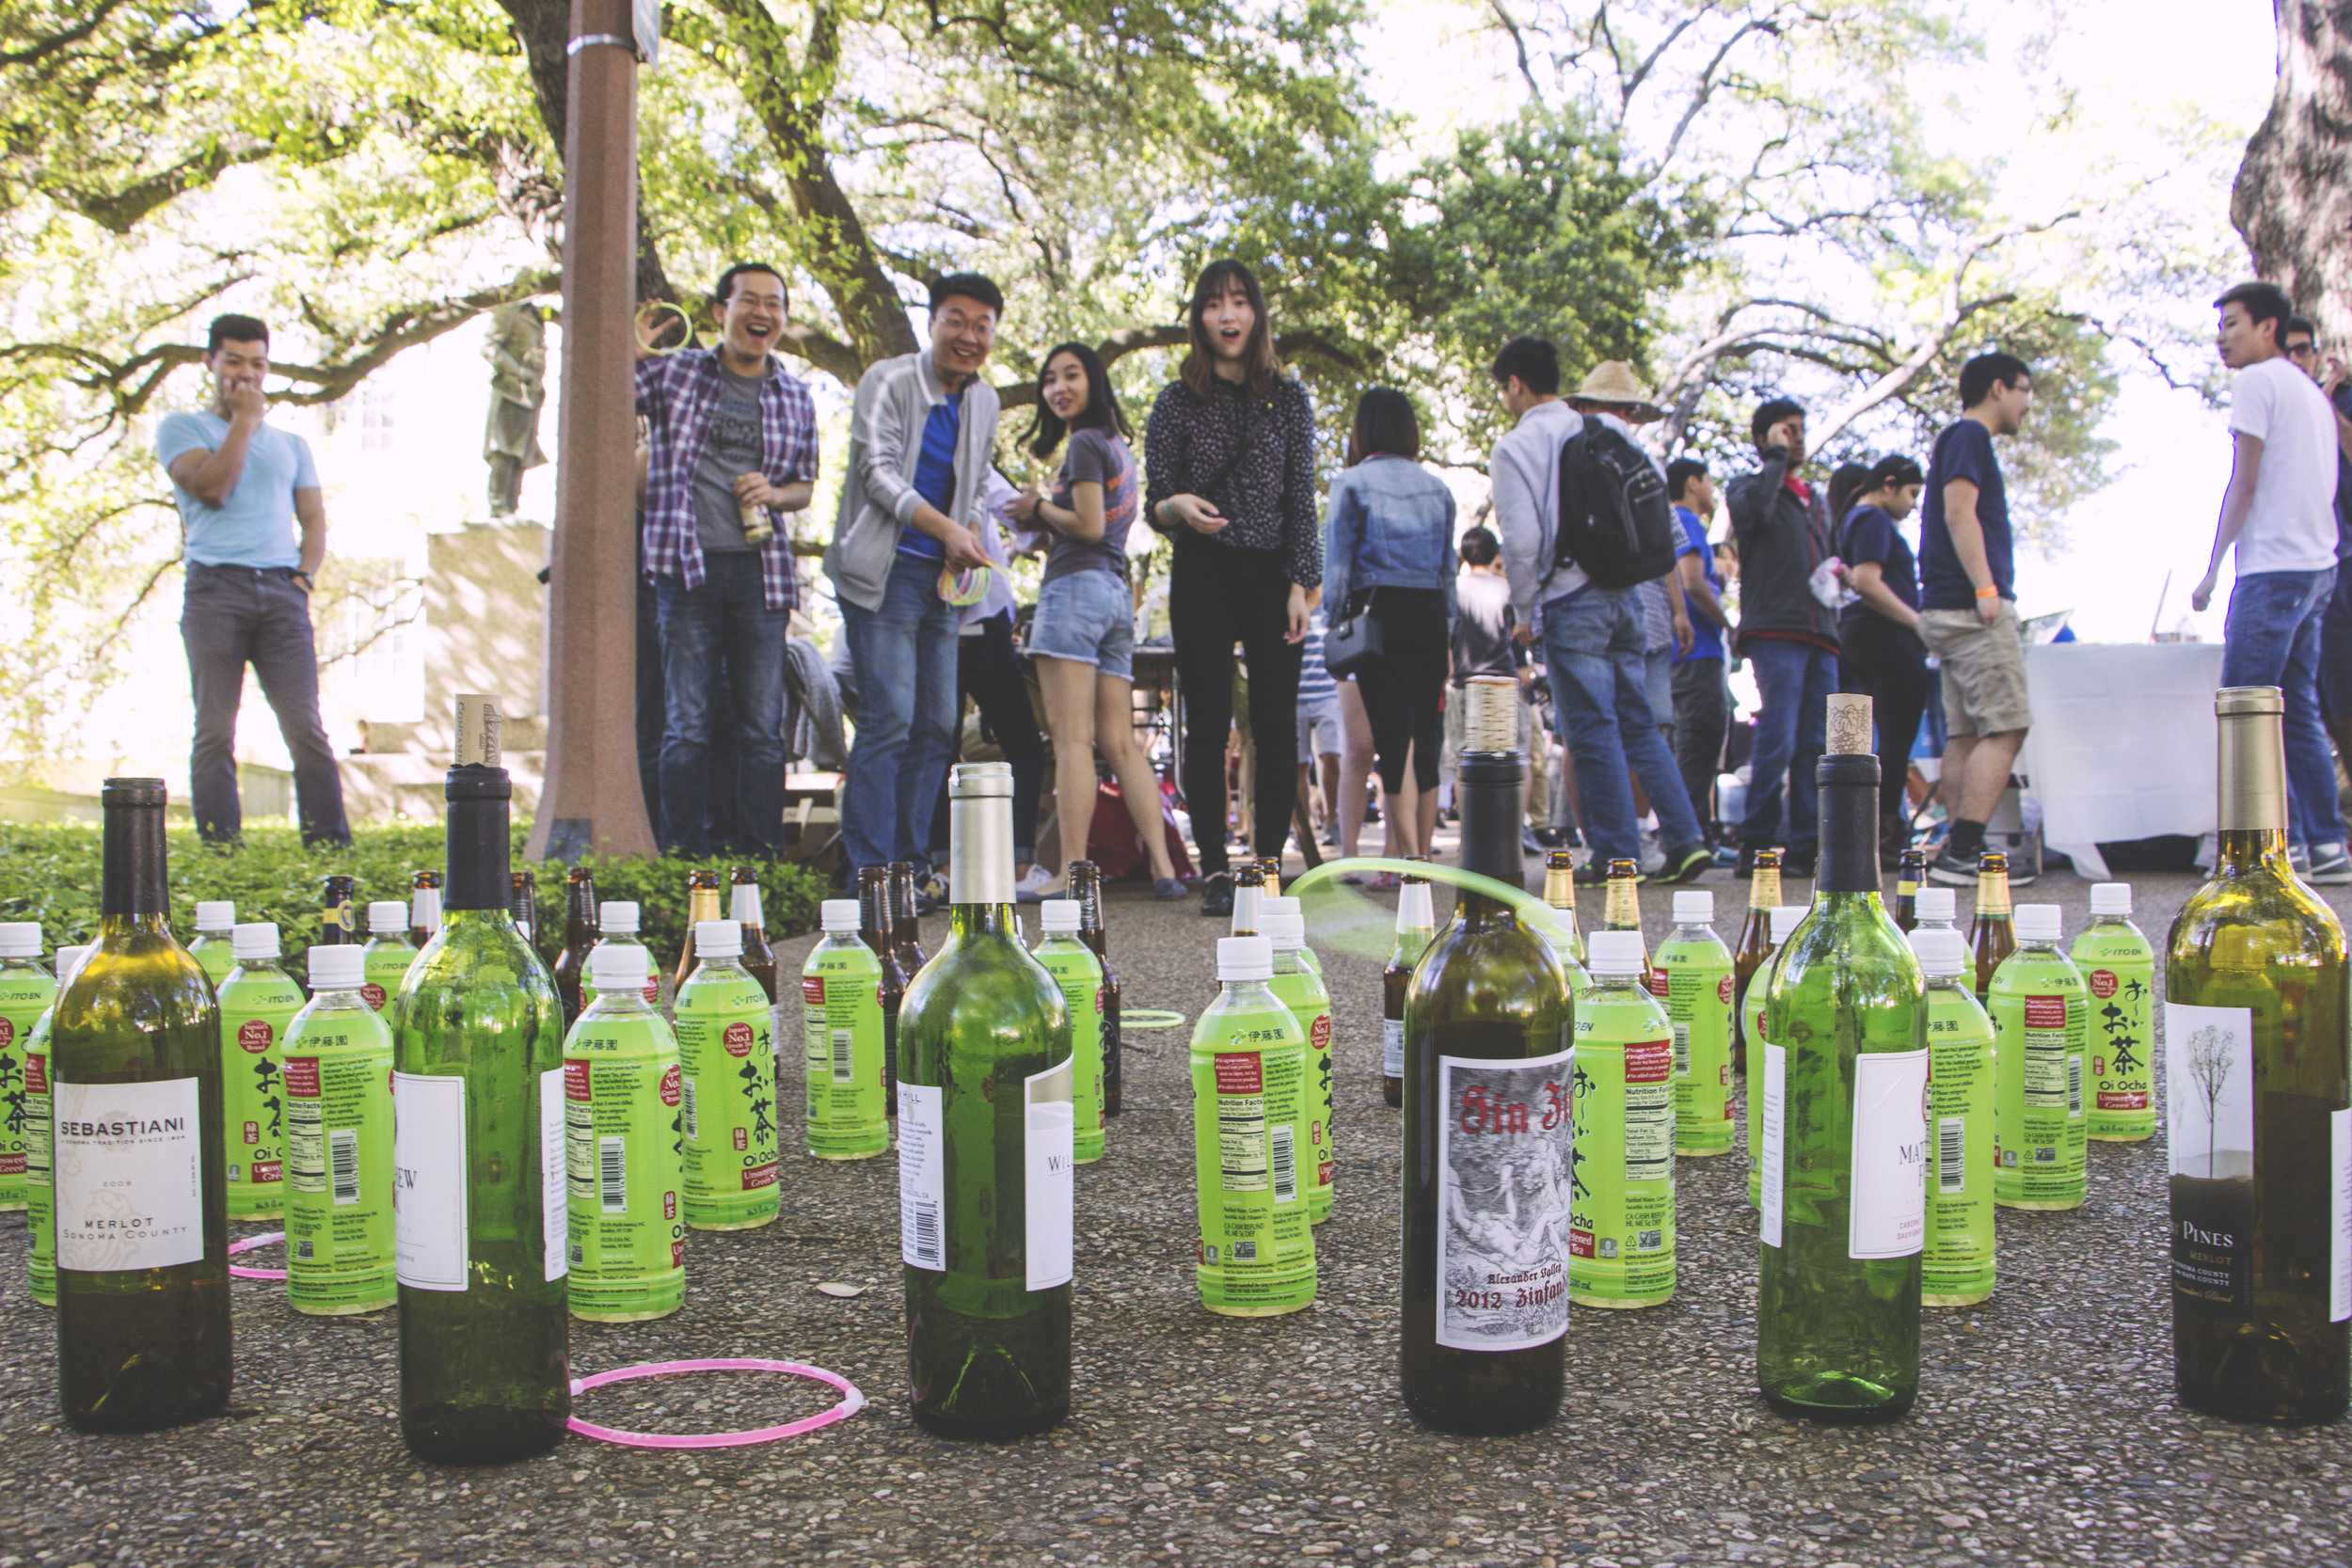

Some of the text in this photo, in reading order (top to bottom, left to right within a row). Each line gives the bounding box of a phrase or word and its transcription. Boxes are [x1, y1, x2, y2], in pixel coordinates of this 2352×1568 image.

[2092, 977, 2114, 986] No.1
[10, 992, 28, 1001] ITO
[1928, 1021, 1958, 1032] 藤園
[245, 1030, 267, 1039] No.1
[727, 1033, 750, 1042] No.1
[1248, 1029, 1285, 1042] 伊藤園
[2100, 1002, 2144, 1076] お茶
[2099, 1079, 2147, 1090] Oi Ocha
[1626, 1087, 1657, 1096] Nutrition
[1459, 1085, 1530, 1135] Sin
[60, 1117, 184, 1136] SEBASTIANI
[254, 1147, 270, 1160] Oi
[743, 1152, 758, 1167] Oi
[84, 1217, 154, 1229] MERLOT
[63, 1226, 188, 1241] SONOMA COUNTY
[2183, 1220, 2233, 1249] PINES
[1572, 1244, 1584, 1254] Tea
[2189, 1250, 2233, 1266] MERLOT
[1486, 1262, 1562, 1285] Alexander Valley
[2197, 1267, 2230, 1279] COUNTY
[2197, 1274, 2230, 1287] COUNTY
[1454, 1288, 1502, 1310] 2012
